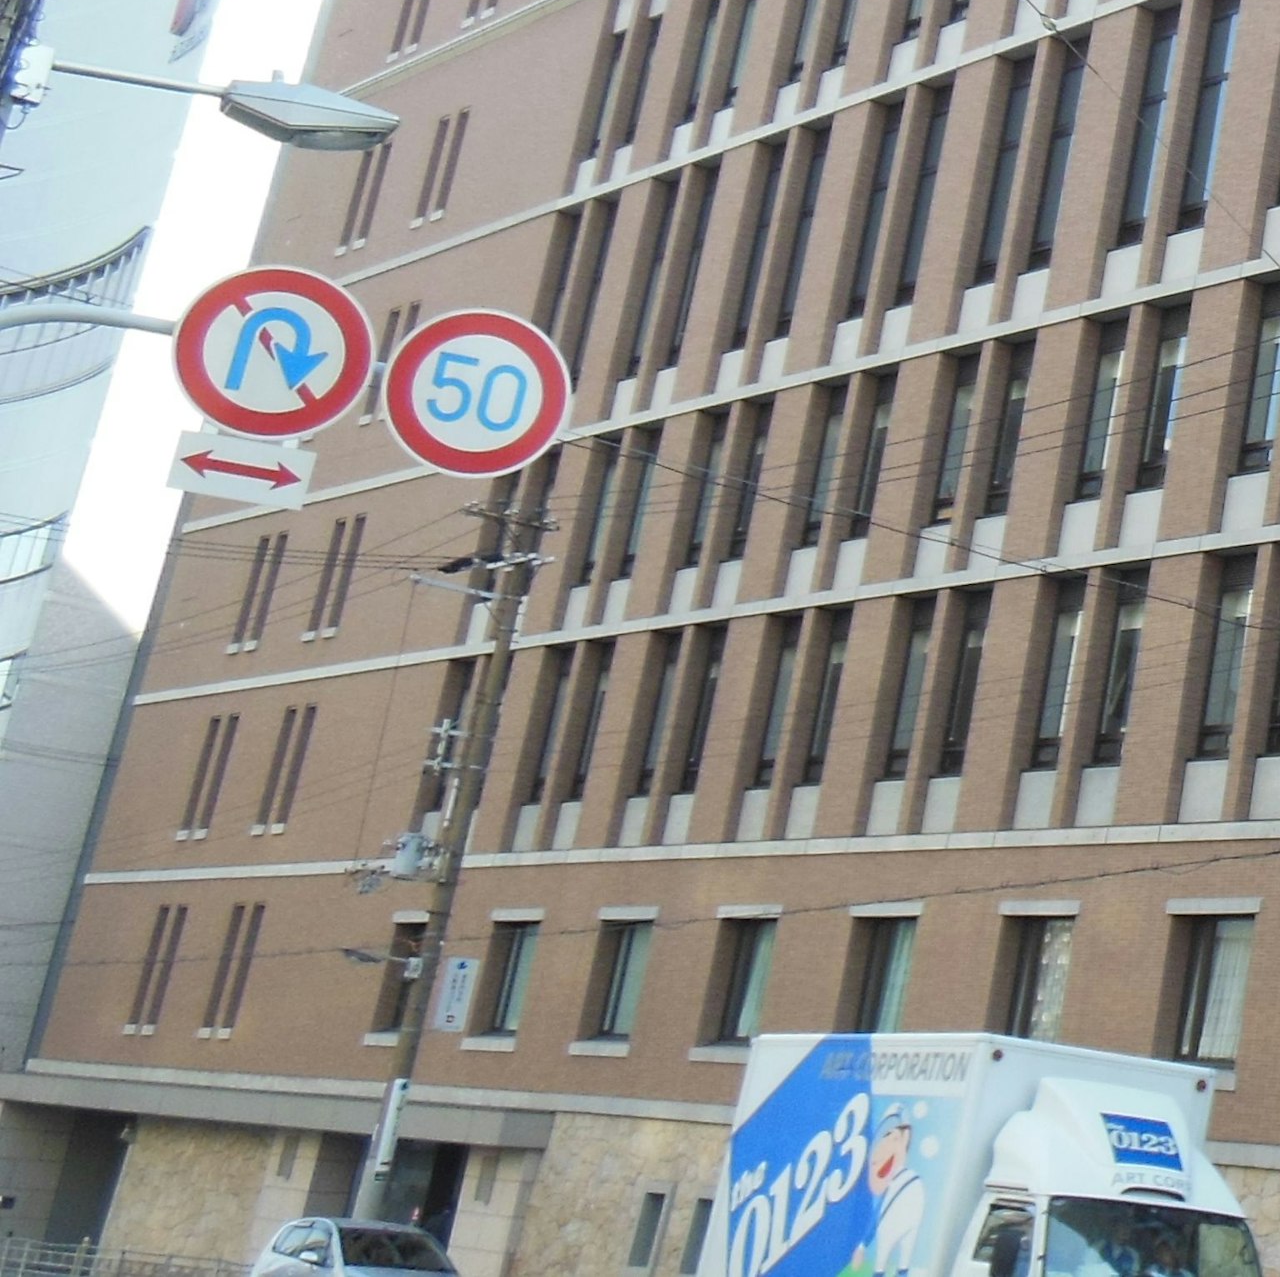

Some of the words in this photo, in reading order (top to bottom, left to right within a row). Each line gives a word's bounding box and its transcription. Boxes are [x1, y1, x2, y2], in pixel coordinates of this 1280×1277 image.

[426, 352, 527, 433] 50
[1108, 1130, 1178, 1155] 0123
[728, 1093, 870, 1277] 0123
